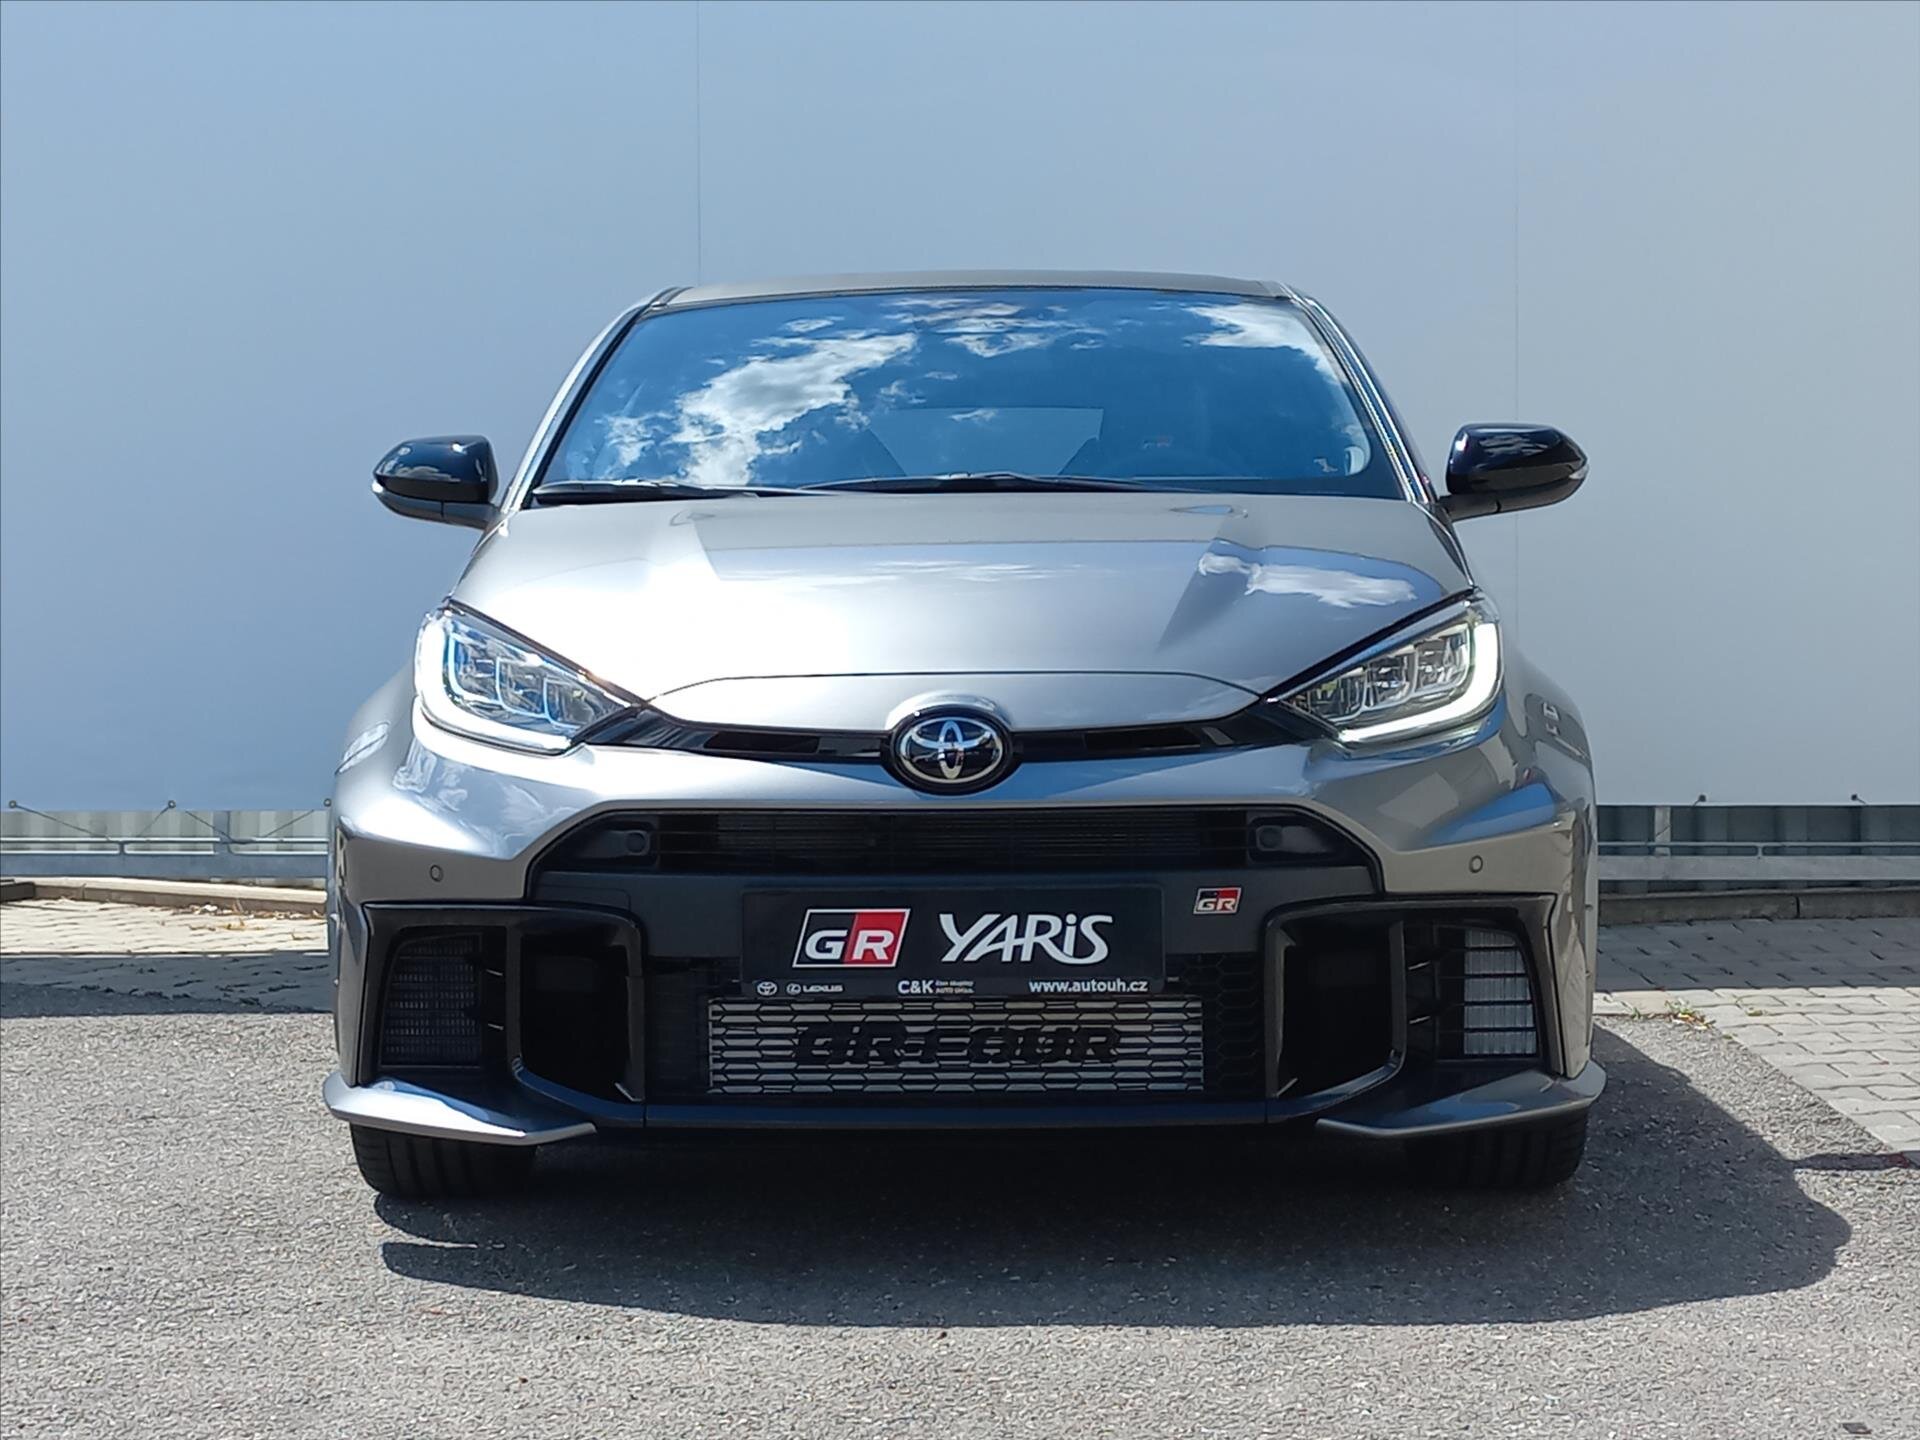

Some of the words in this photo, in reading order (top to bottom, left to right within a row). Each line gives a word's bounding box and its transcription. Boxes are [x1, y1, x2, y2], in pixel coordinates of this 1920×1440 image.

[1197, 898, 1236, 911] GR
[805, 929, 895, 961] GR
[802, 984, 844, 993] LEXUS
[898, 980, 935, 994] C&K
[1028, 978, 1149, 993] www.autouh.cz
